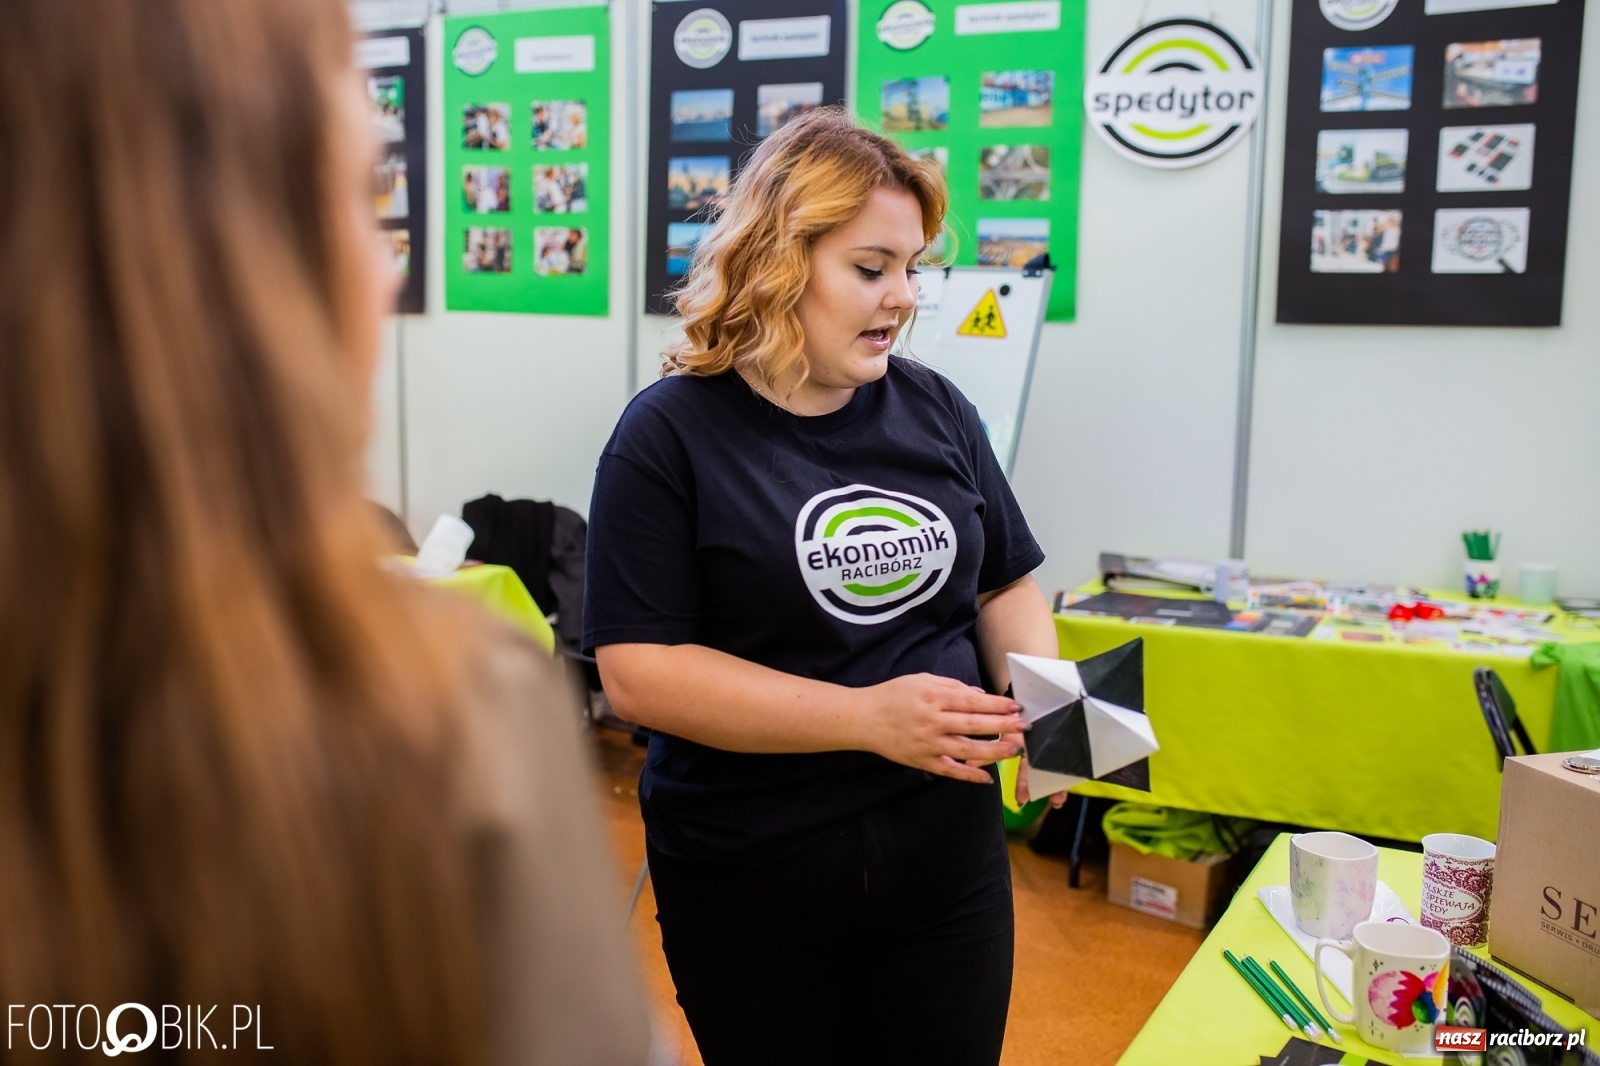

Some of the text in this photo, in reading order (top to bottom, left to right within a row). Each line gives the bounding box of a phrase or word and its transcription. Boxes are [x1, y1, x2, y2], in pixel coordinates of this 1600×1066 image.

[1094, 85, 1254, 118] spedytor
[807, 526, 949, 570] ekonomik
[841, 557, 923, 581] RACIBÓRZ
[1423, 882, 1455, 899] OLSKIE
[1422, 899, 1449, 915] OLĘDY
[1540, 921, 1573, 941] SERWIS
